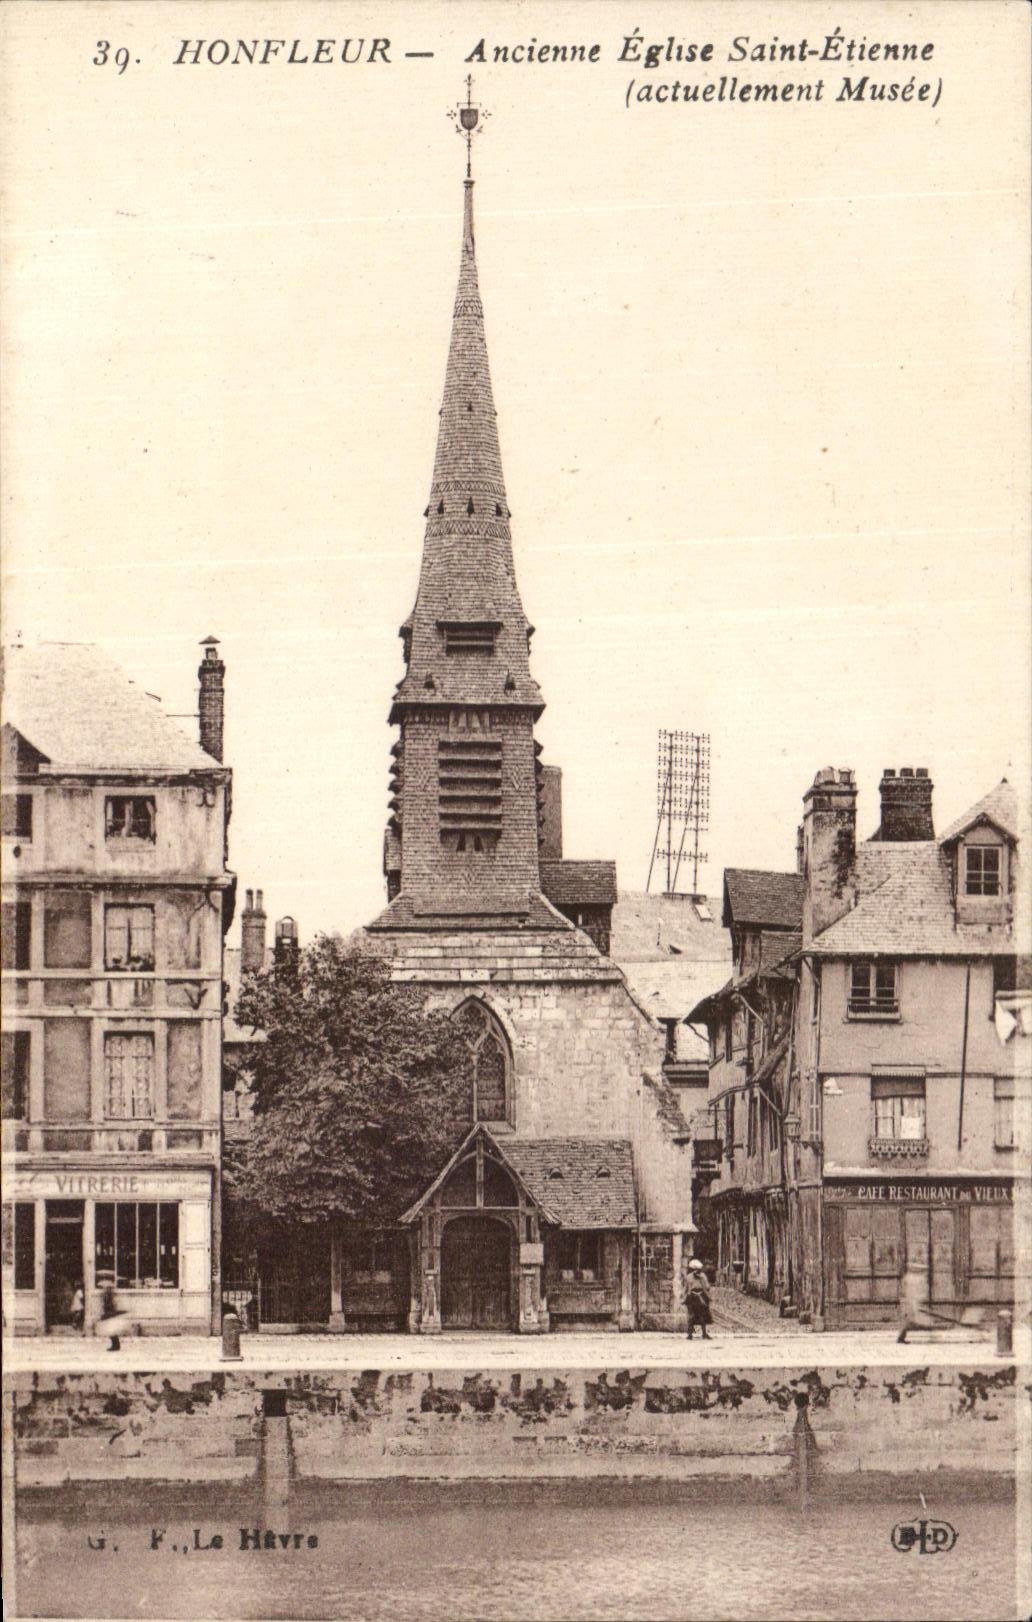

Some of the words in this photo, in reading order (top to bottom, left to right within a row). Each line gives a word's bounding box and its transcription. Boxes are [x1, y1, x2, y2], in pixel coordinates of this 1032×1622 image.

[55, 1174, 139, 1194] VITRERIE
[889, 1185, 958, 1200] RESTAURANT
[974, 1185, 1009, 1201] VIEUX
